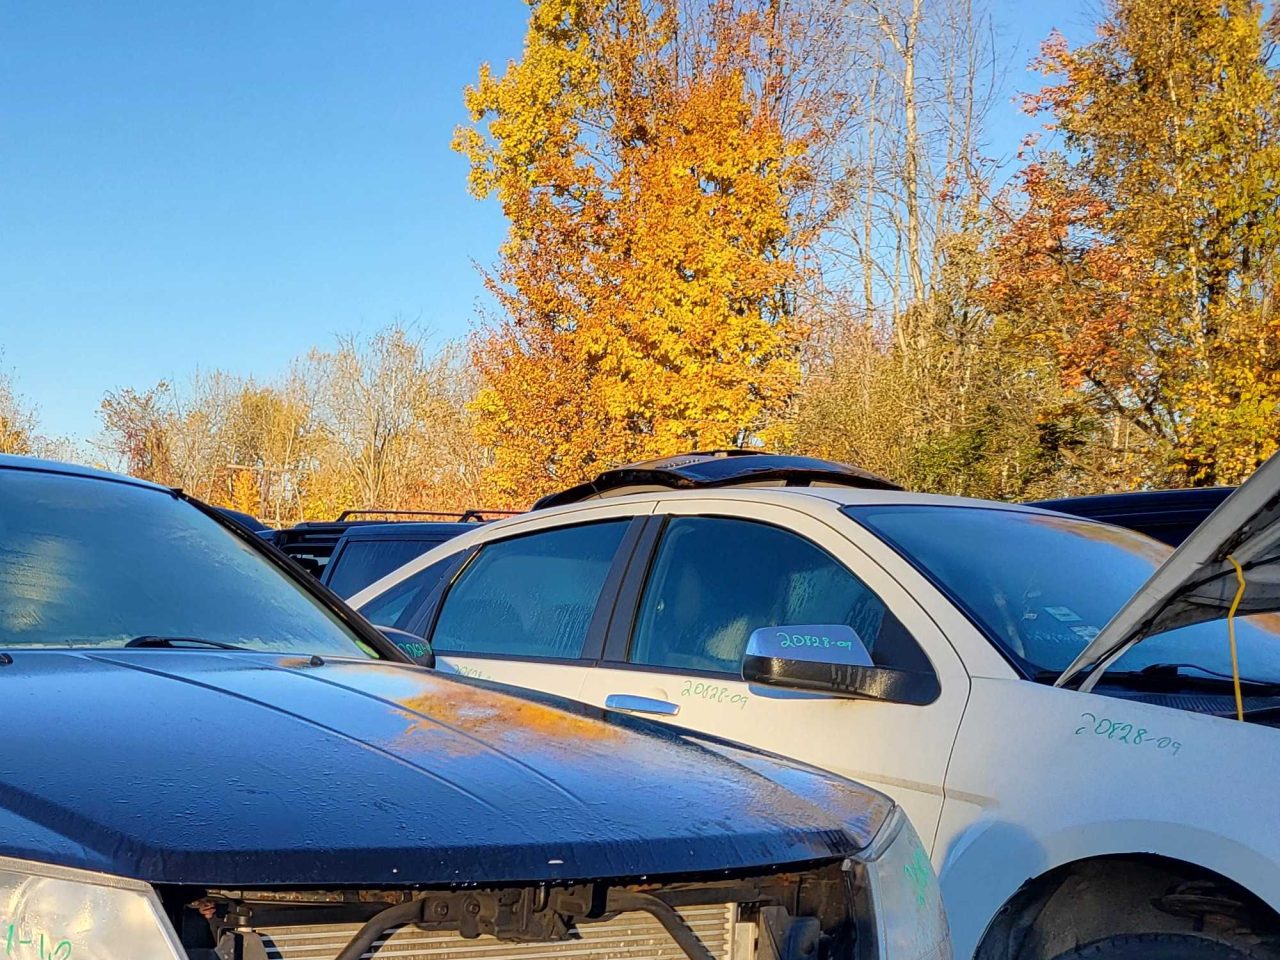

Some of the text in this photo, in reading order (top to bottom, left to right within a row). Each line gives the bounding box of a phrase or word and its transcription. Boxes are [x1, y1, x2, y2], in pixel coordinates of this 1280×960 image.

[776, 631, 852, 650] 20828-09
[681, 679, 749, 711] 20828-09
[1075, 712, 1182, 756] 20828-09
